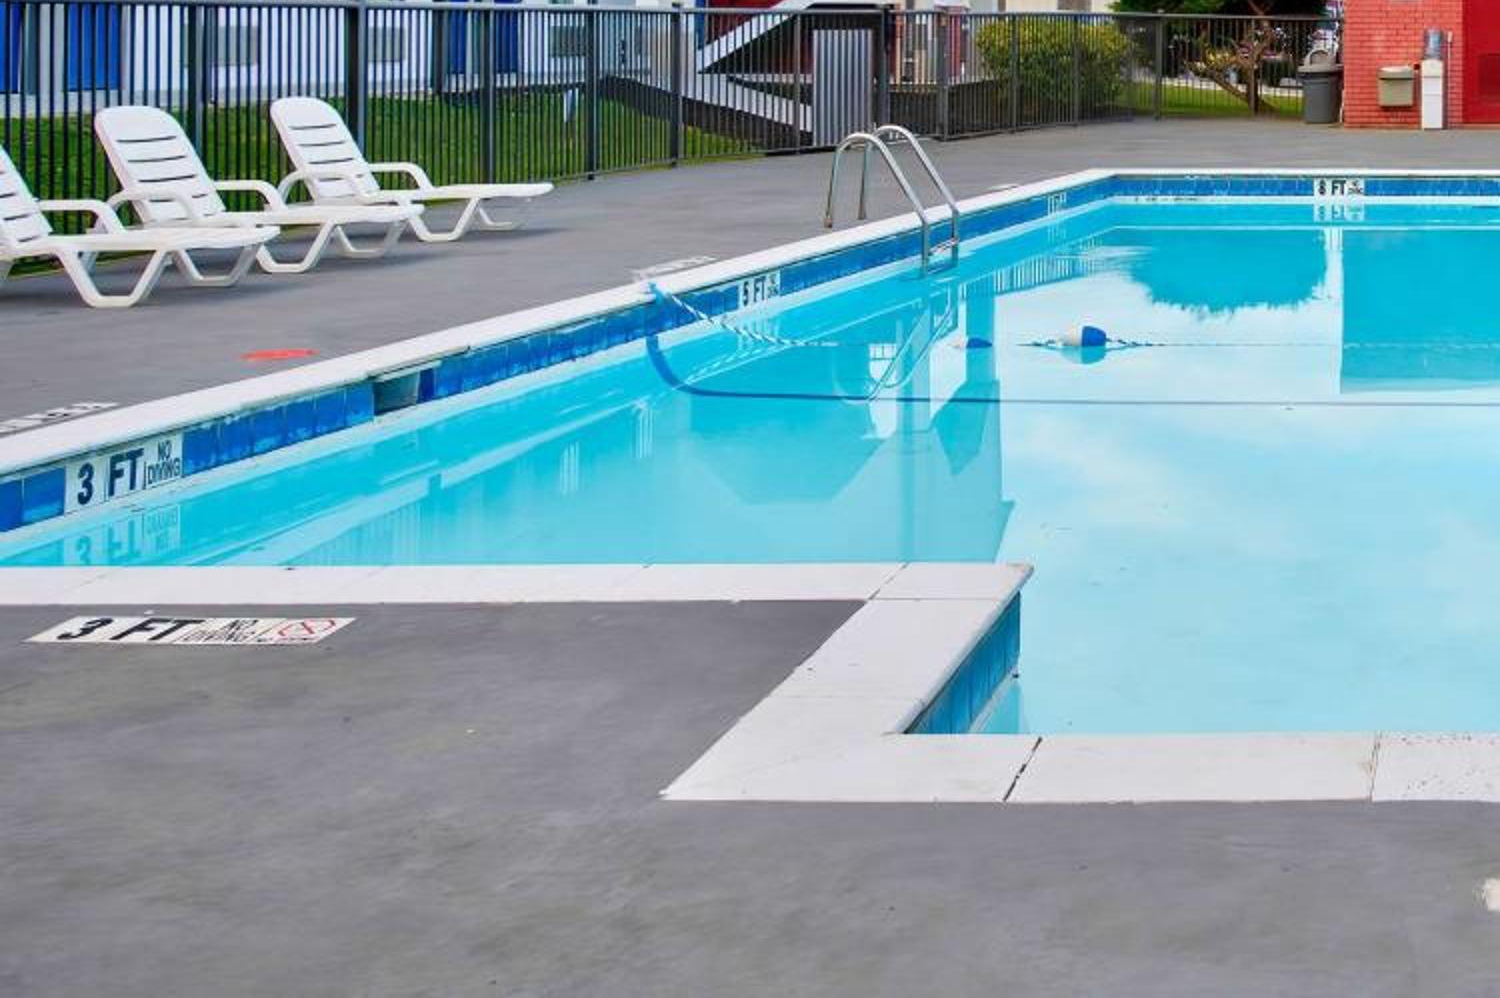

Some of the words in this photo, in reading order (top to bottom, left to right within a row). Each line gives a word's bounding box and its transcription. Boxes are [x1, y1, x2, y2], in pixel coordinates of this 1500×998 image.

[1317, 179, 1327, 196] 8
[1331, 179, 1346, 196] FT
[753, 275, 767, 303] FT
[157, 439, 172, 460] NO
[77, 462, 94, 505] 3
[108, 447, 144, 497] FT
[147, 458, 181, 484] DIVING
[57, 617, 114, 640] 3
[109, 617, 206, 641] FT
